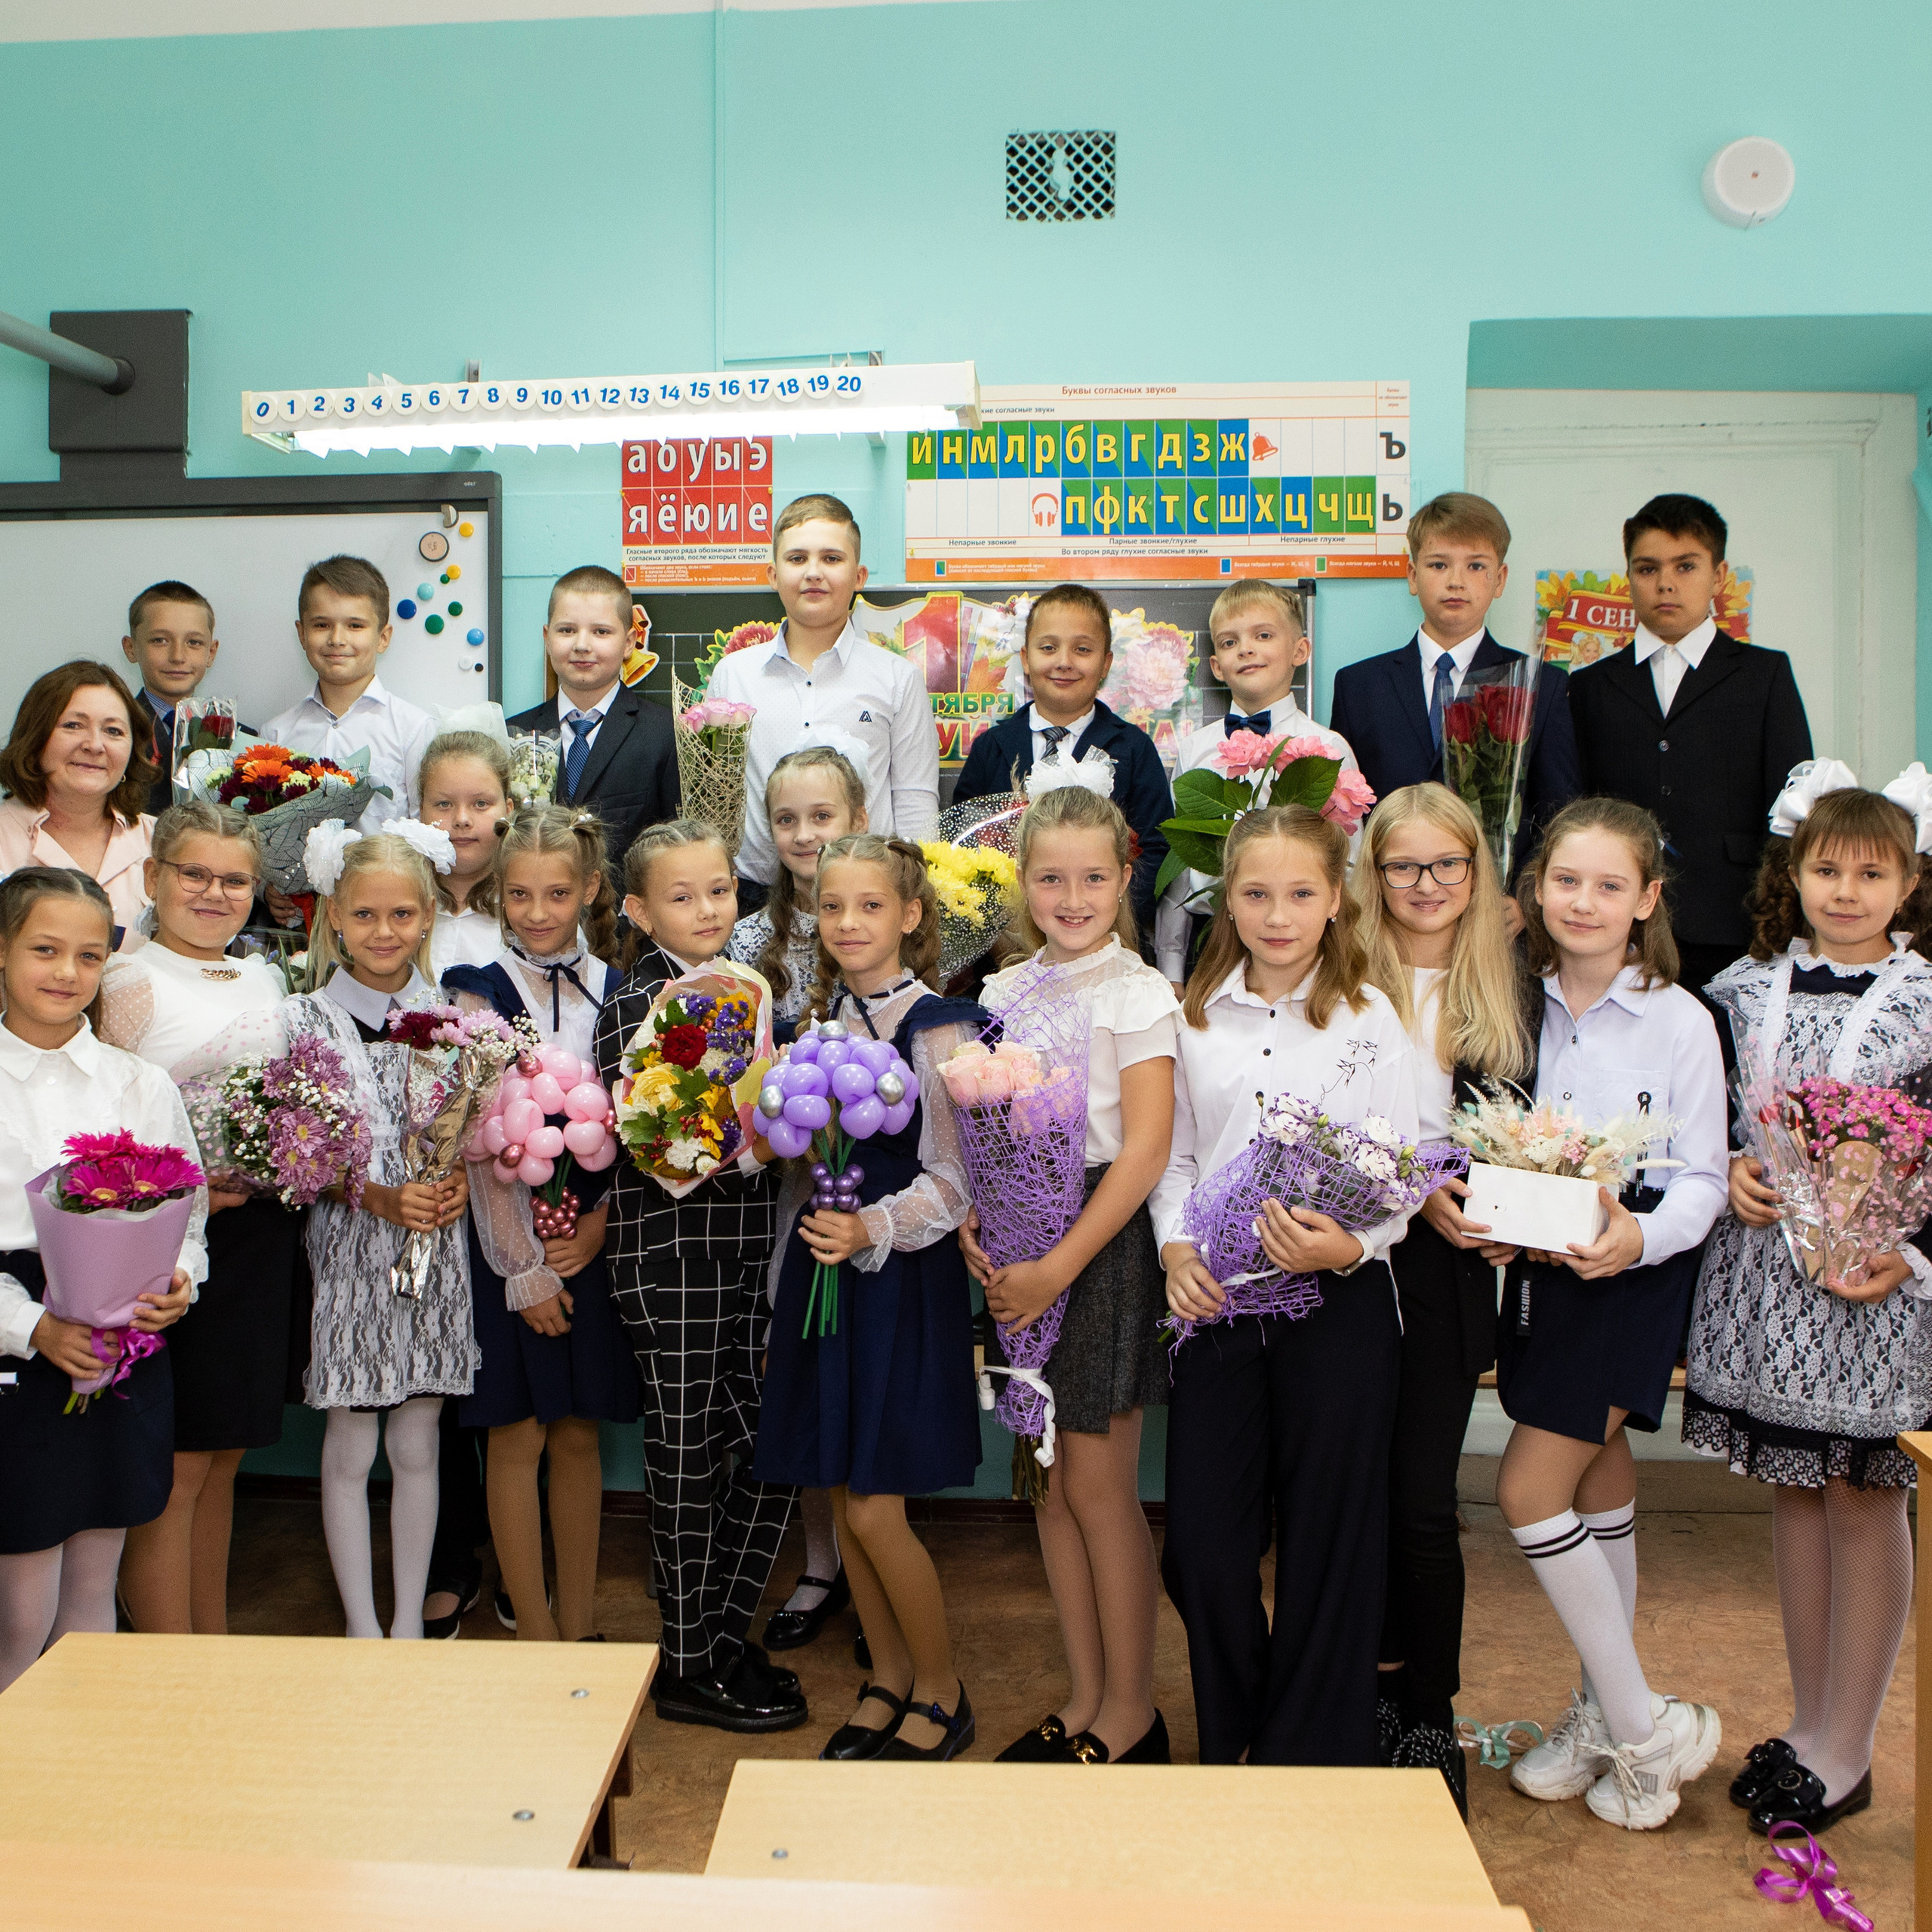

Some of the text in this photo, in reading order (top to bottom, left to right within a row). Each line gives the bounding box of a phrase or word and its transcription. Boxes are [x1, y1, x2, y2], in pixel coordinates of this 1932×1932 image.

[257, 375, 861, 417] 0 1 2 3 4 5 6 7 8 9 10 11 12 13 14 15 16 17 18 19 20
[1062, 386, 1177, 395] Буквы согласных звуков
[928, 692, 1015, 715] ТЯБРЯ
[1521, 1279, 1531, 1326] FASHION
